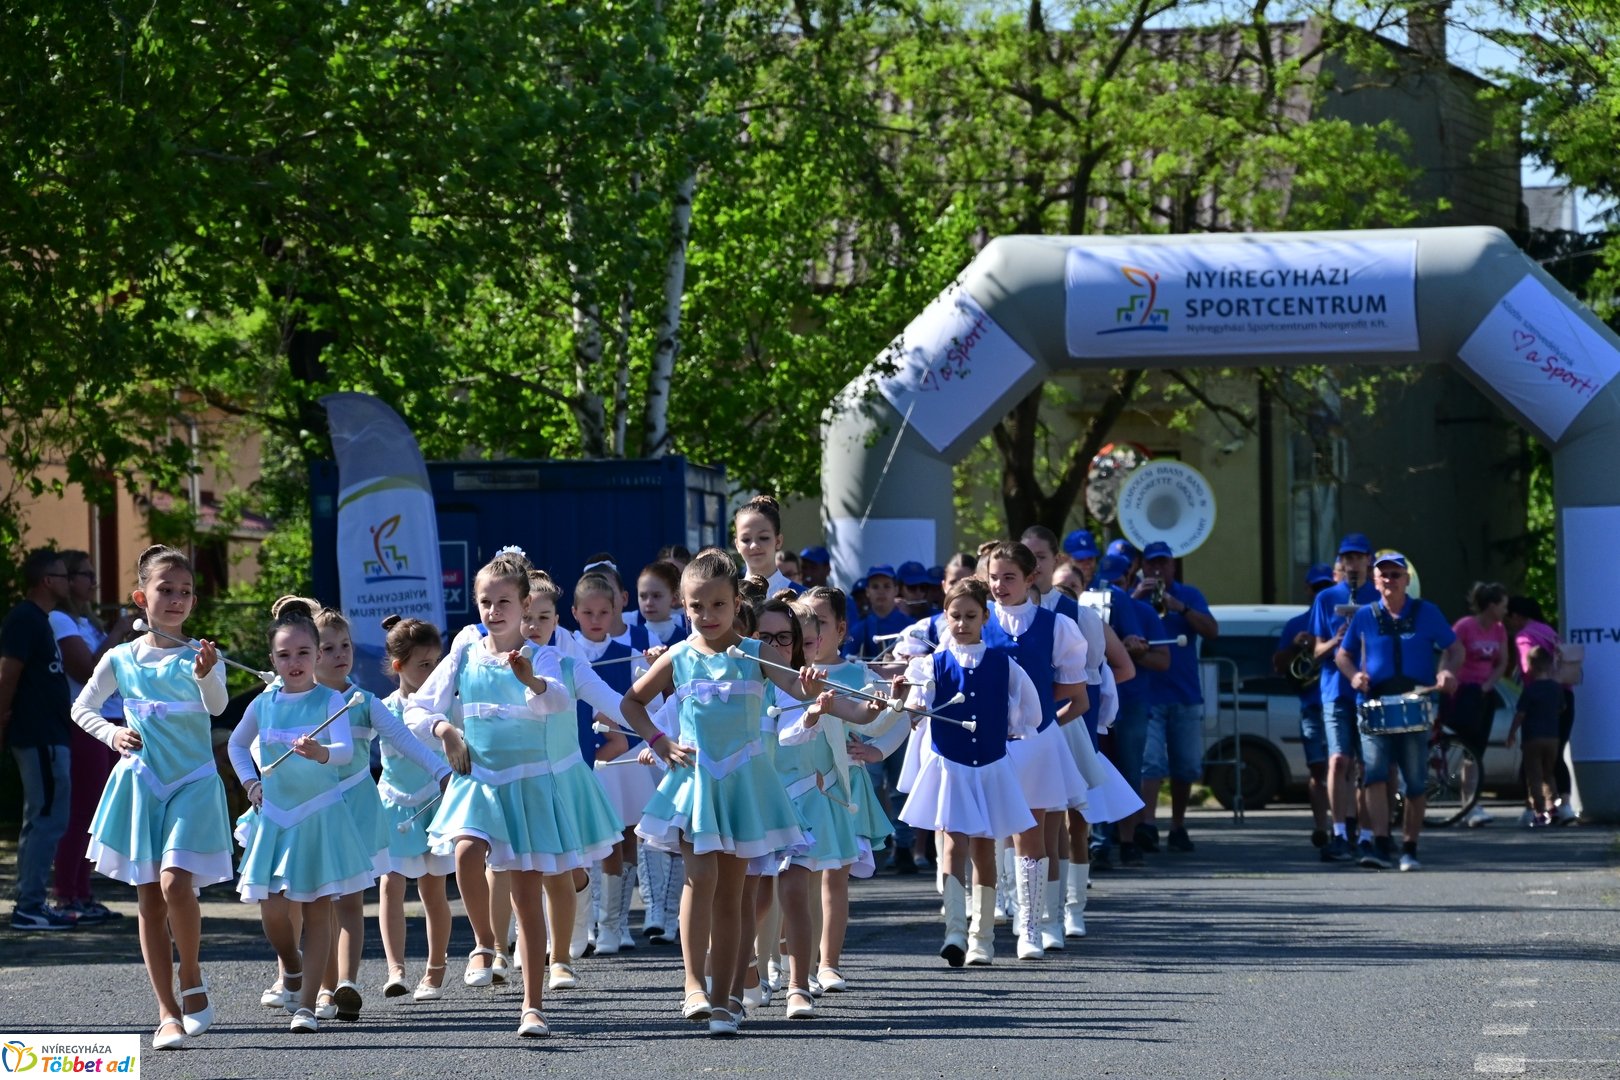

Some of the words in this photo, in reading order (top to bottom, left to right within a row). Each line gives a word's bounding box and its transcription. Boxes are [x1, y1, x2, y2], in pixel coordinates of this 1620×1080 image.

[1186, 264, 1349, 289] NYÍREGYHÁZI
[1186, 294, 1387, 319] SPORTCENTRUM
[1247, 321, 1317, 334] Sportcentrum
[1320, 319, 1367, 332] Nonprofit
[1526, 351, 1542, 364] a
[1541, 356, 1600, 398] Sport!
